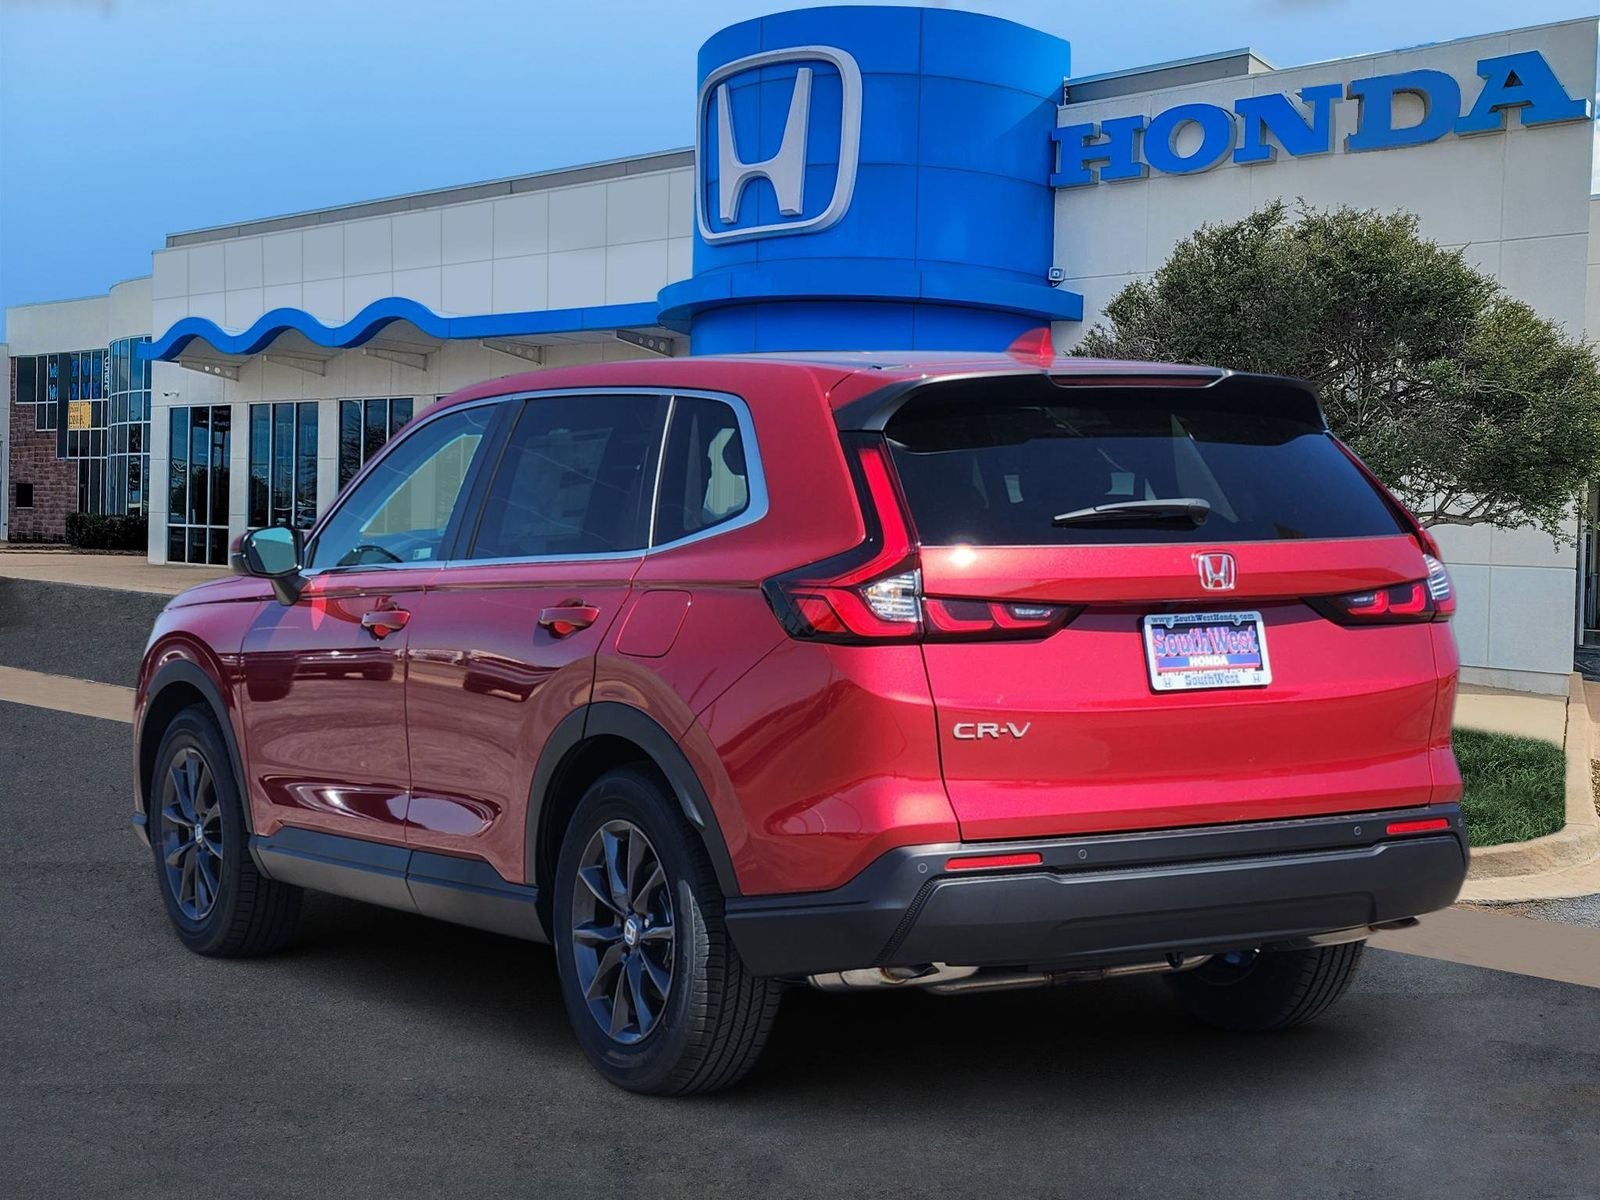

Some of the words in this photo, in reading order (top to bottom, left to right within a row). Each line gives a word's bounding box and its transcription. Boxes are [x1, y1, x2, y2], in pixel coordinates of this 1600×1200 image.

[1050, 50, 1592, 188] HONDA
[1152, 625, 1258, 656] SouthWest
[1189, 655, 1230, 668] HONDA
[953, 722, 1031, 739] CR-V
